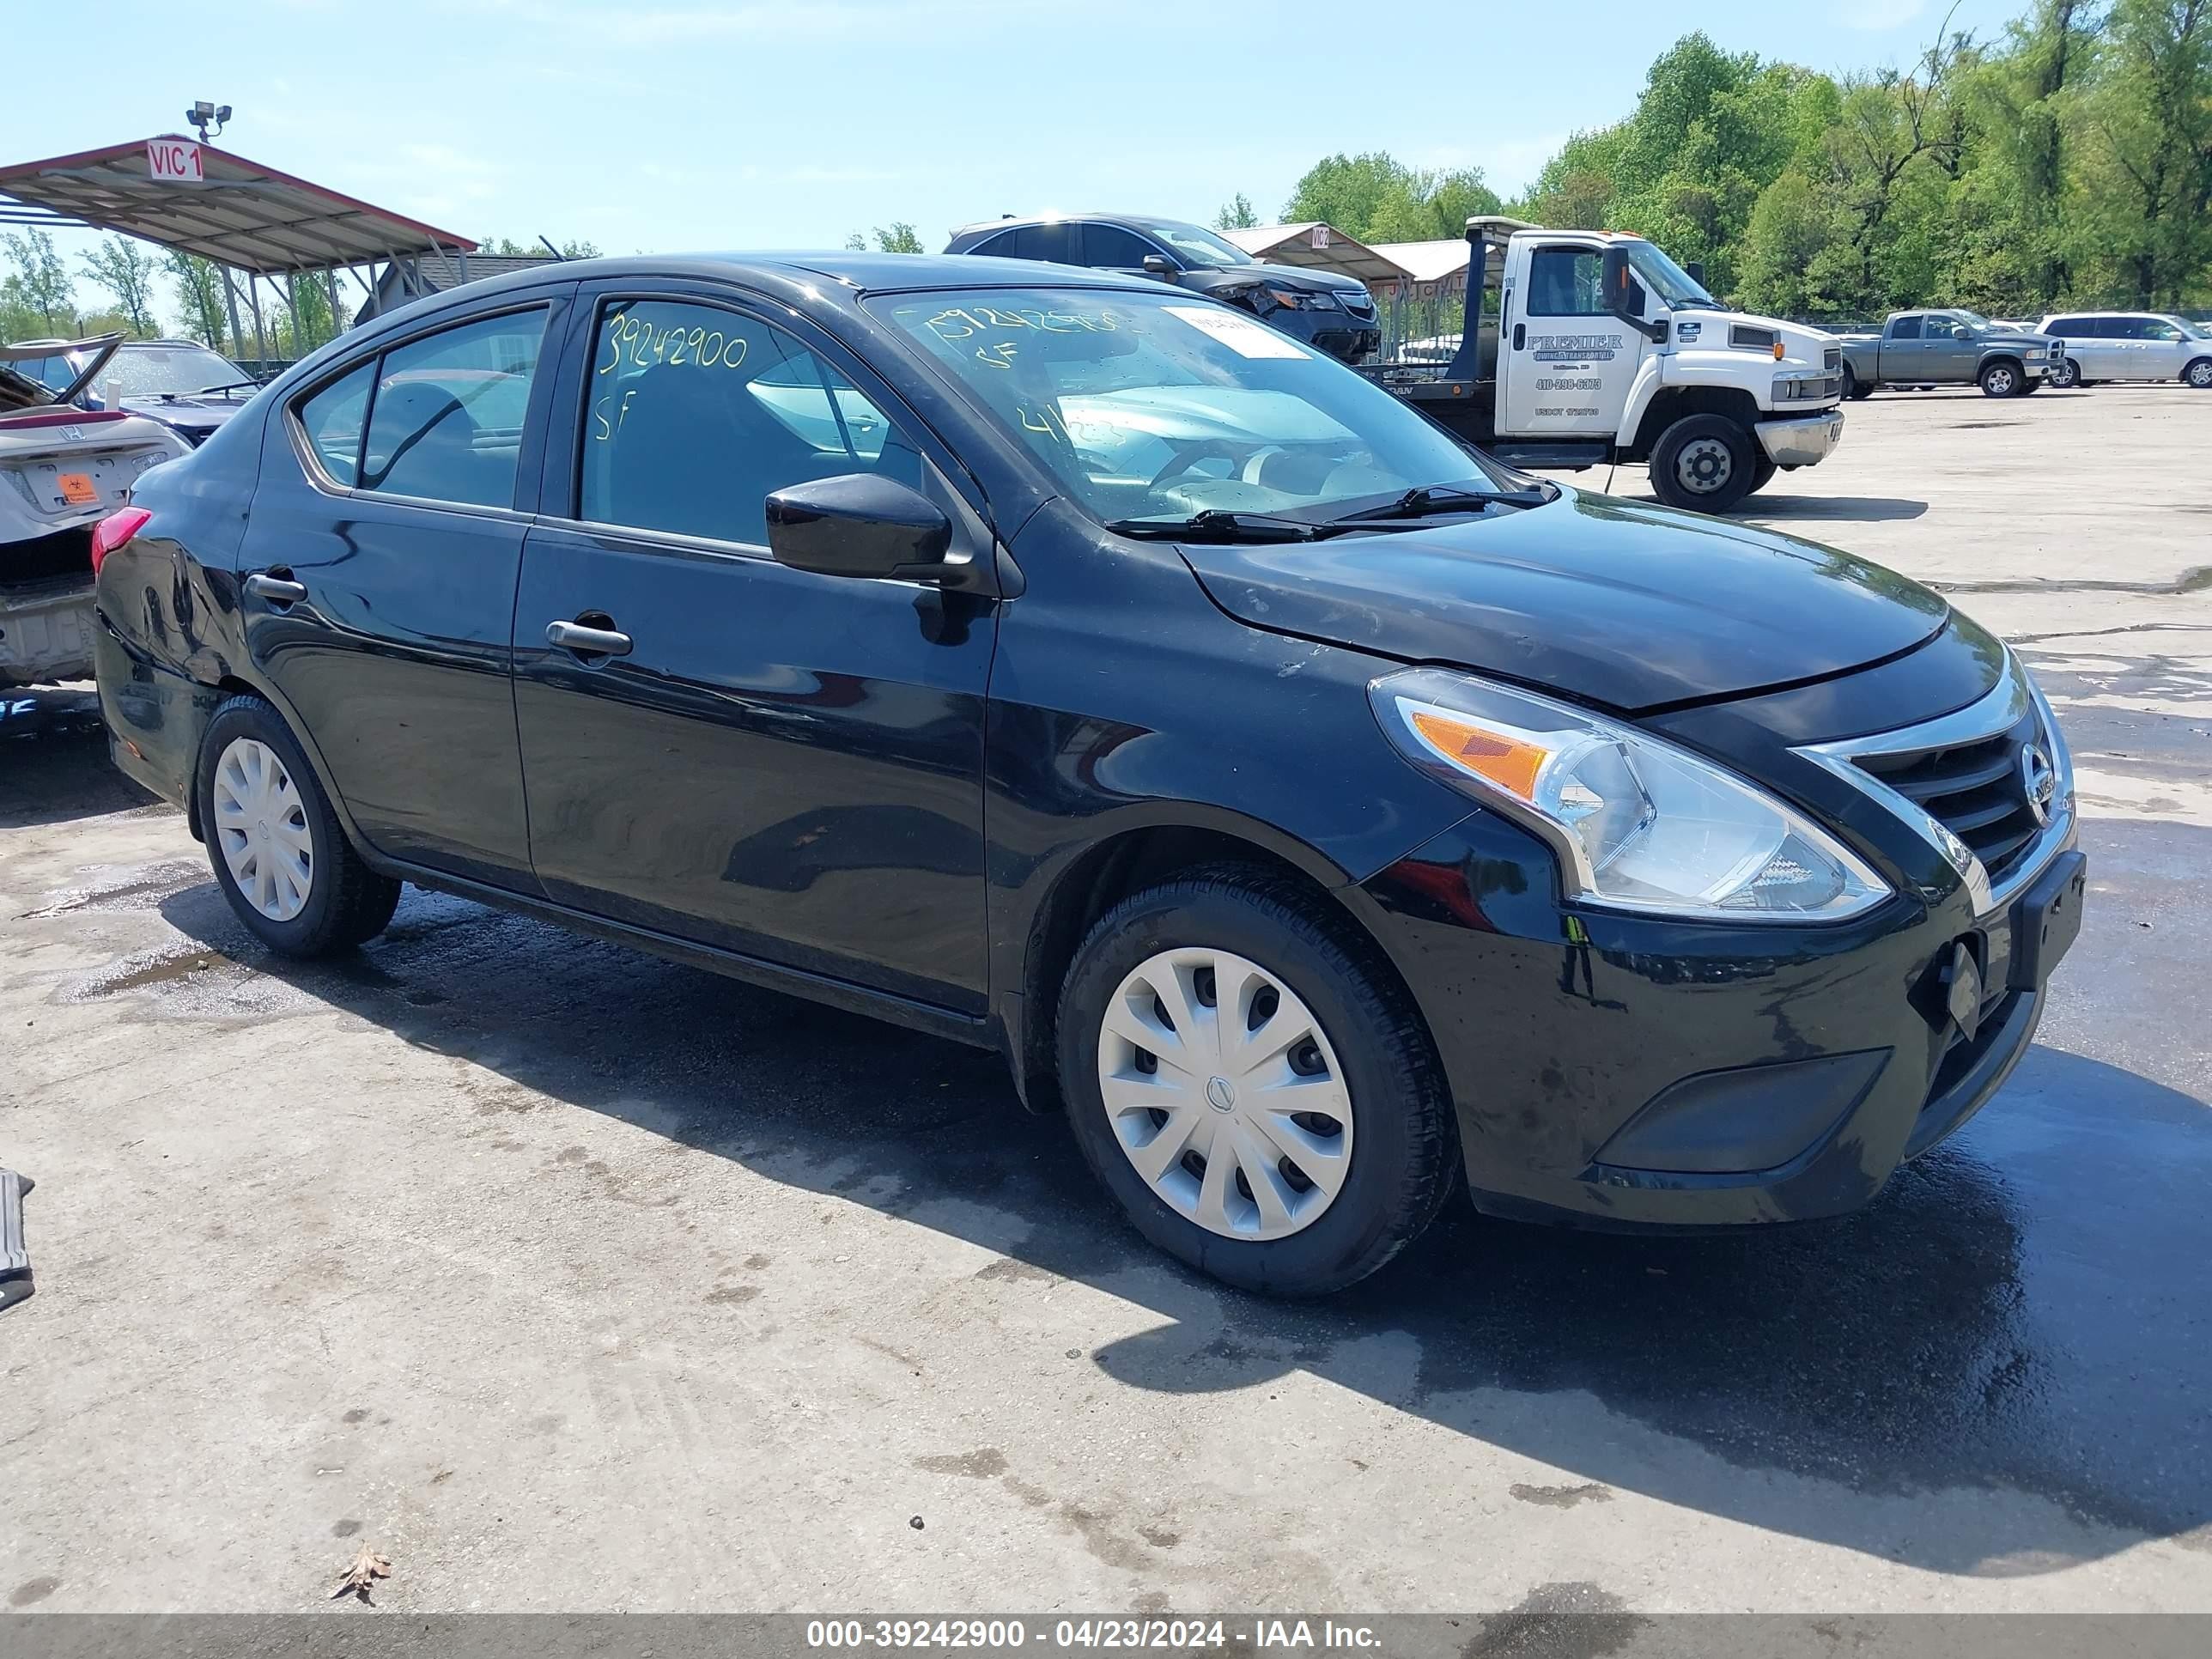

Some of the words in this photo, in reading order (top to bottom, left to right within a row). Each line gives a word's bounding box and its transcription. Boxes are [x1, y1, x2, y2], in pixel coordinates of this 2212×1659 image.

[149, 146, 185, 175] VIC
[190, 149, 201, 176] 1
[1314, 230, 1323, 246] VIC
[1324, 231, 1329, 245] 2
[599, 310, 747, 374] 39242900
[1527, 335, 1623, 349] PREMIER
[975, 342, 1018, 370] SF
[1534, 351, 1558, 360] TOWING
[1536, 379, 1601, 390] 410-298-6373
[594, 390, 637, 441] SF
[1535, 408, 1564, 416] USDOT
